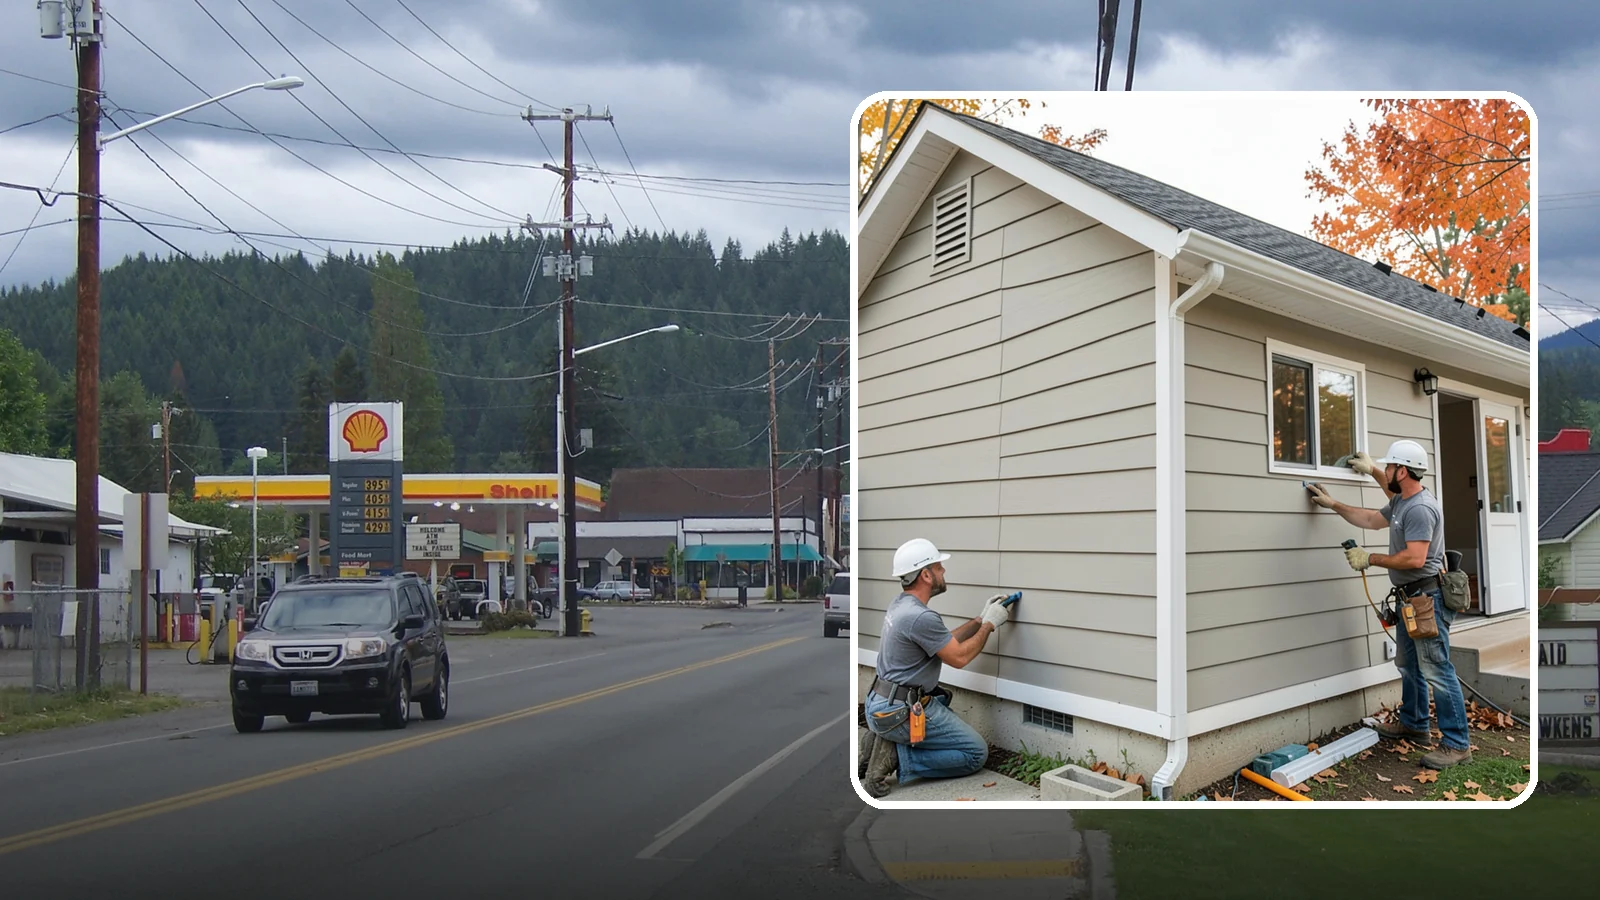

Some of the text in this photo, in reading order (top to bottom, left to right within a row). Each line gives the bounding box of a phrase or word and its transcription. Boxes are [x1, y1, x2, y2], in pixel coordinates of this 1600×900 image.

[366, 480, 384, 490] 395
[490, 484, 547, 499] Shell
[366, 494, 384, 504] 405
[366, 508, 384, 518] 415
[366, 522, 384, 532] 429
